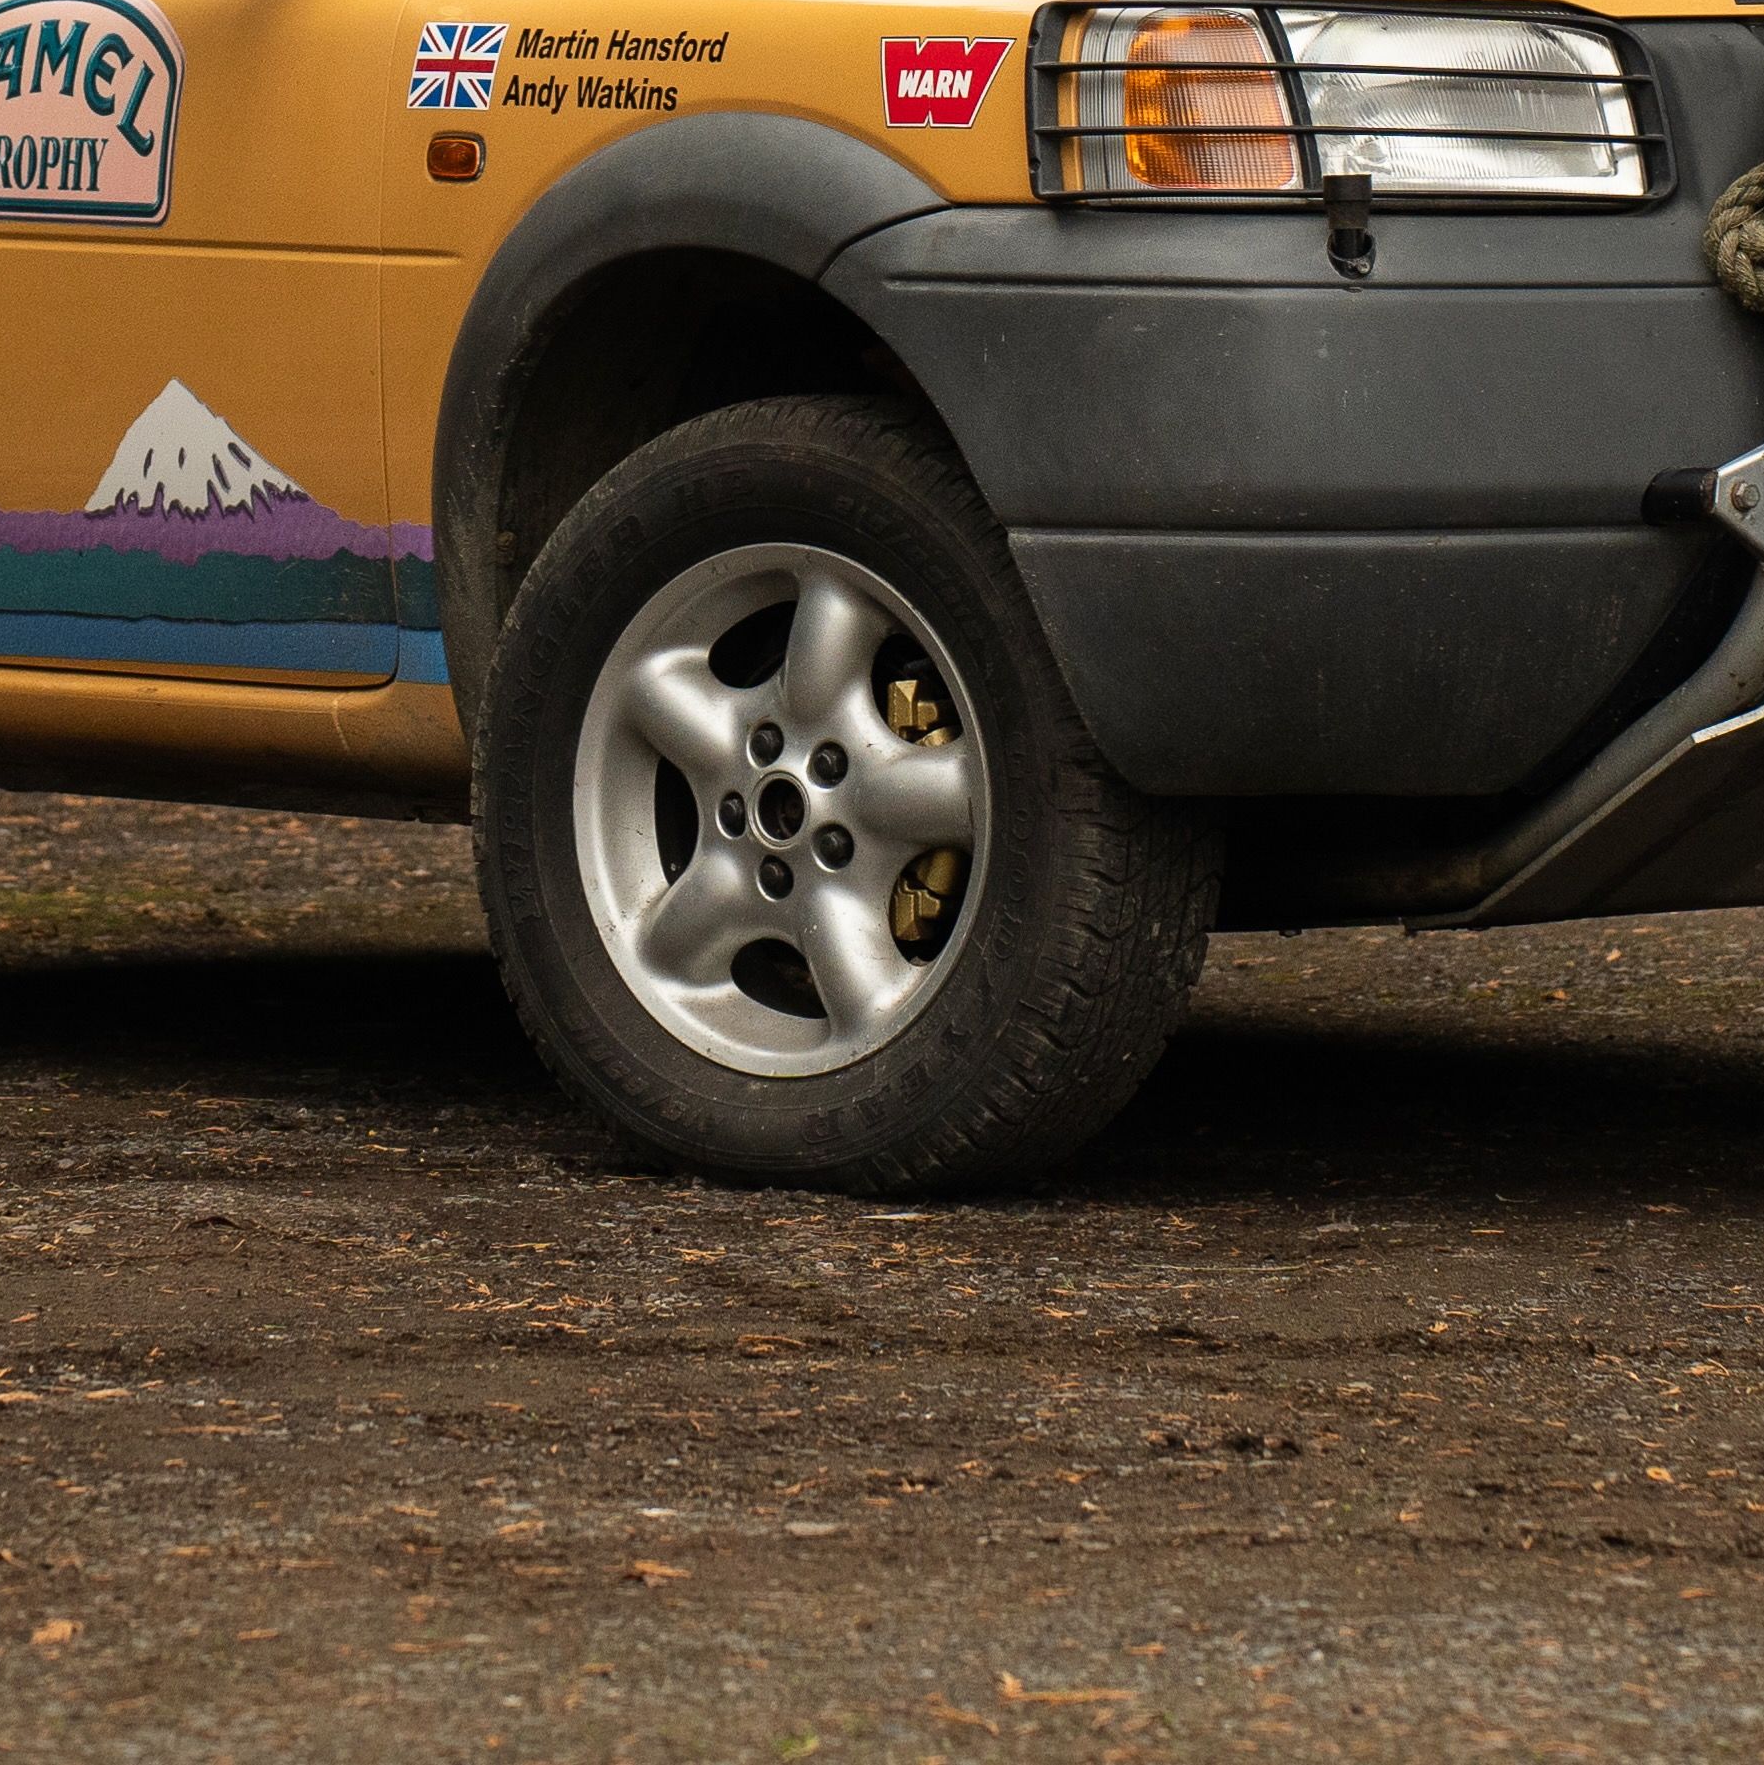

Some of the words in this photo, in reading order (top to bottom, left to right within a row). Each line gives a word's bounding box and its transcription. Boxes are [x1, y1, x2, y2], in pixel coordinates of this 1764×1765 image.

[515, 28, 600, 61] Martin
[605, 29, 729, 63] Hansford
[501, 75, 569, 114] Andy
[575, 76, 678, 111] Watkins
[897, 69, 973, 99] WARN
